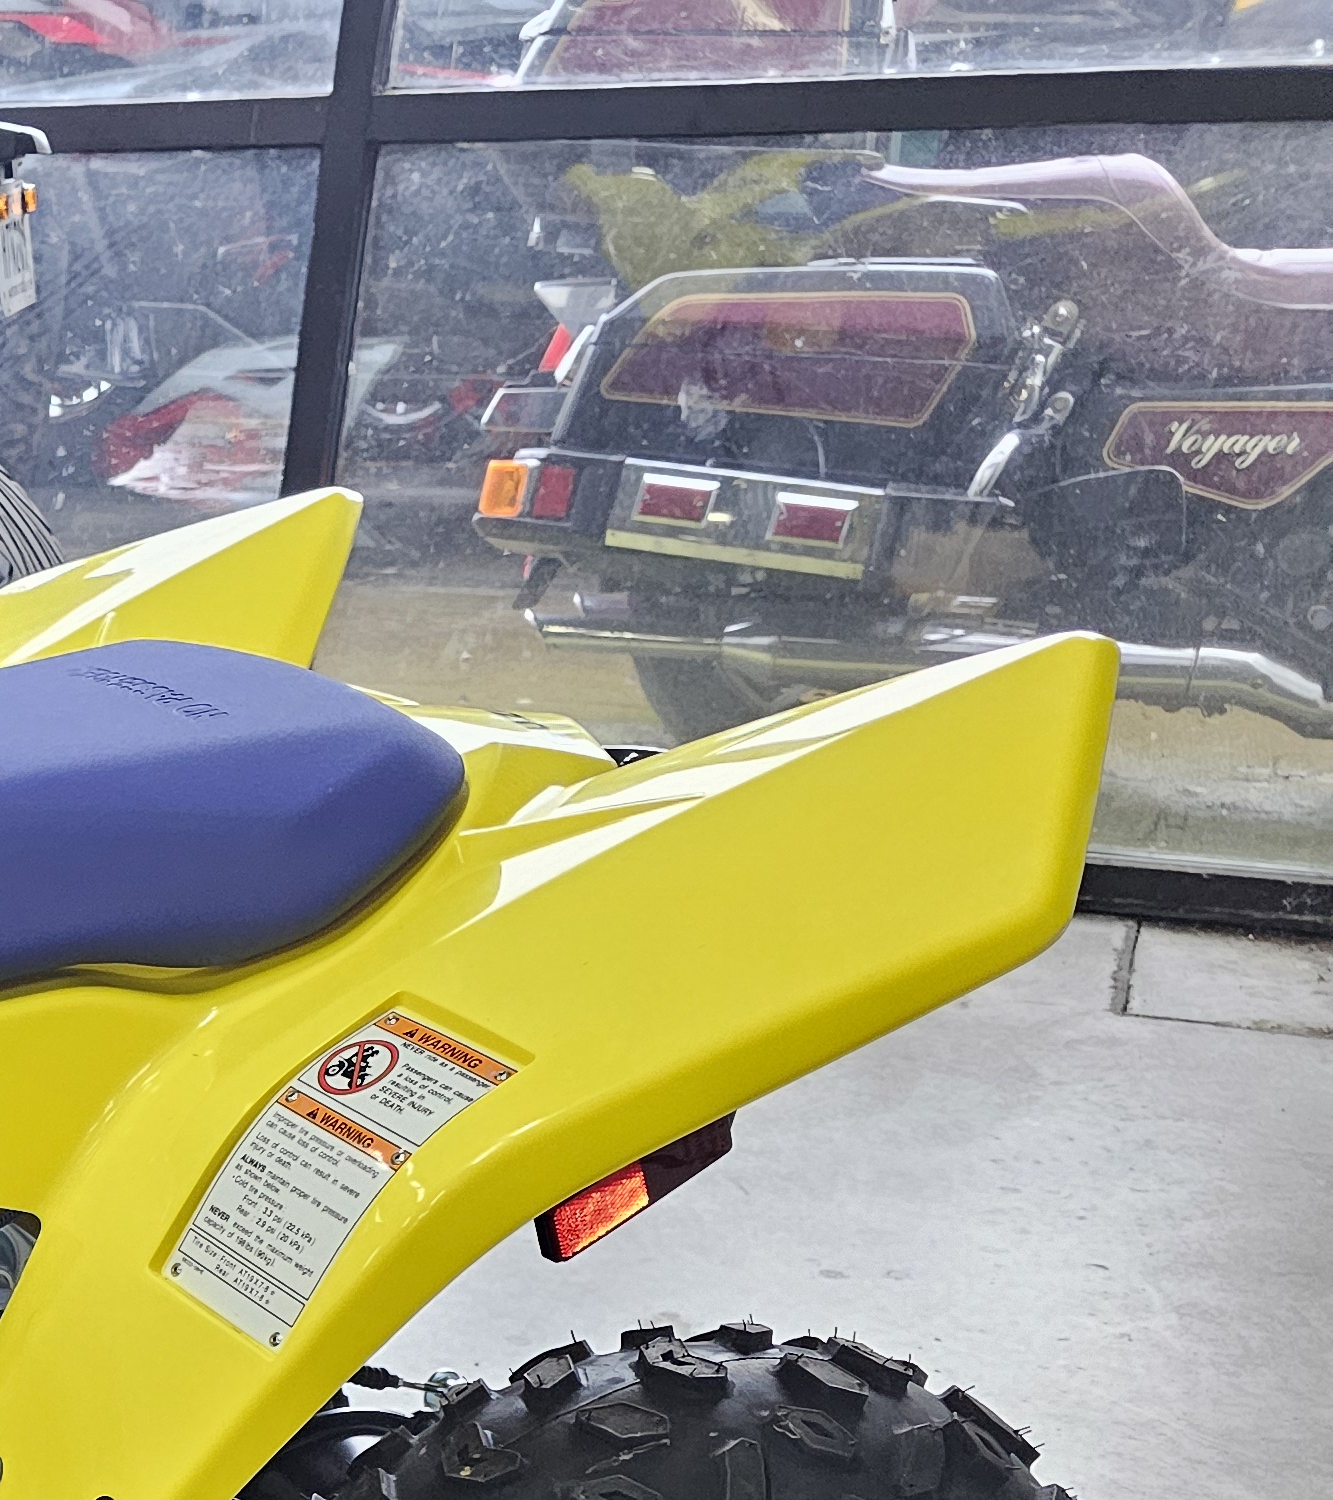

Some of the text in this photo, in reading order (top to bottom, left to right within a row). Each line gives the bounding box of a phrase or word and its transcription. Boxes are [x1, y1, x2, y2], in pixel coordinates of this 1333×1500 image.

[1164, 418, 1300, 469] Voyager
[417, 1033, 483, 1069] WARNING
[379, 1085, 434, 1116] SEVERE INJURY
[388, 1079, 417, 1097] resulting
[401, 1063, 474, 1102] Passengers can cause
[404, 1075, 418, 1085] loss
[427, 1089, 453, 1104] control,
[319, 1112, 375, 1149] WARNING
